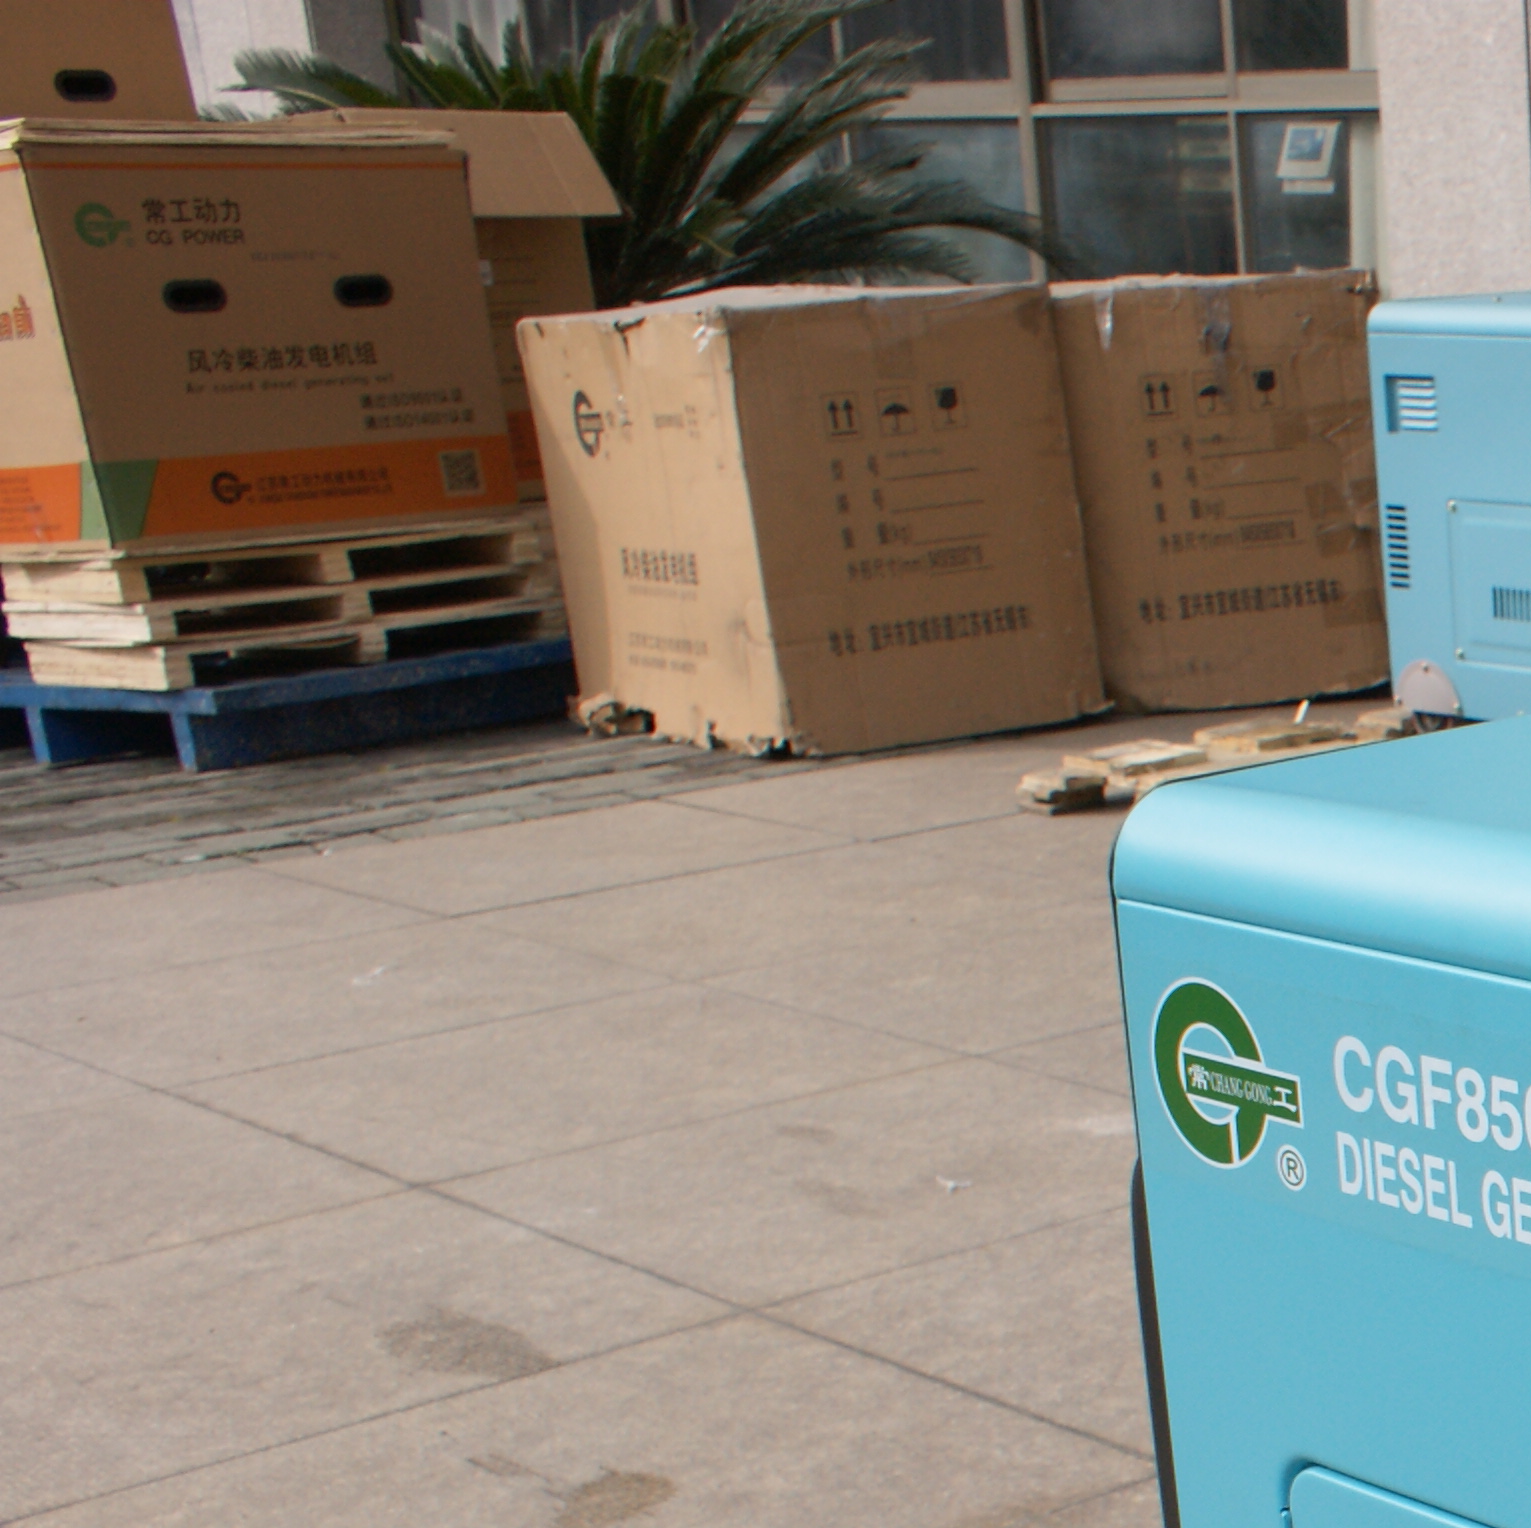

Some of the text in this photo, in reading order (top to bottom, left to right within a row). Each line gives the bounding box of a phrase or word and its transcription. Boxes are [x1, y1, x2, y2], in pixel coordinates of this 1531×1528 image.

[142, 198, 241, 223] 常工动力
[145, 228, 245, 245] CG POWER
[187, 341, 378, 373] 风冷柴油发电机组
[1210, 1071, 1274, 1106] CHANG GONG
[1335, 1129, 1473, 1229] DIESEL
